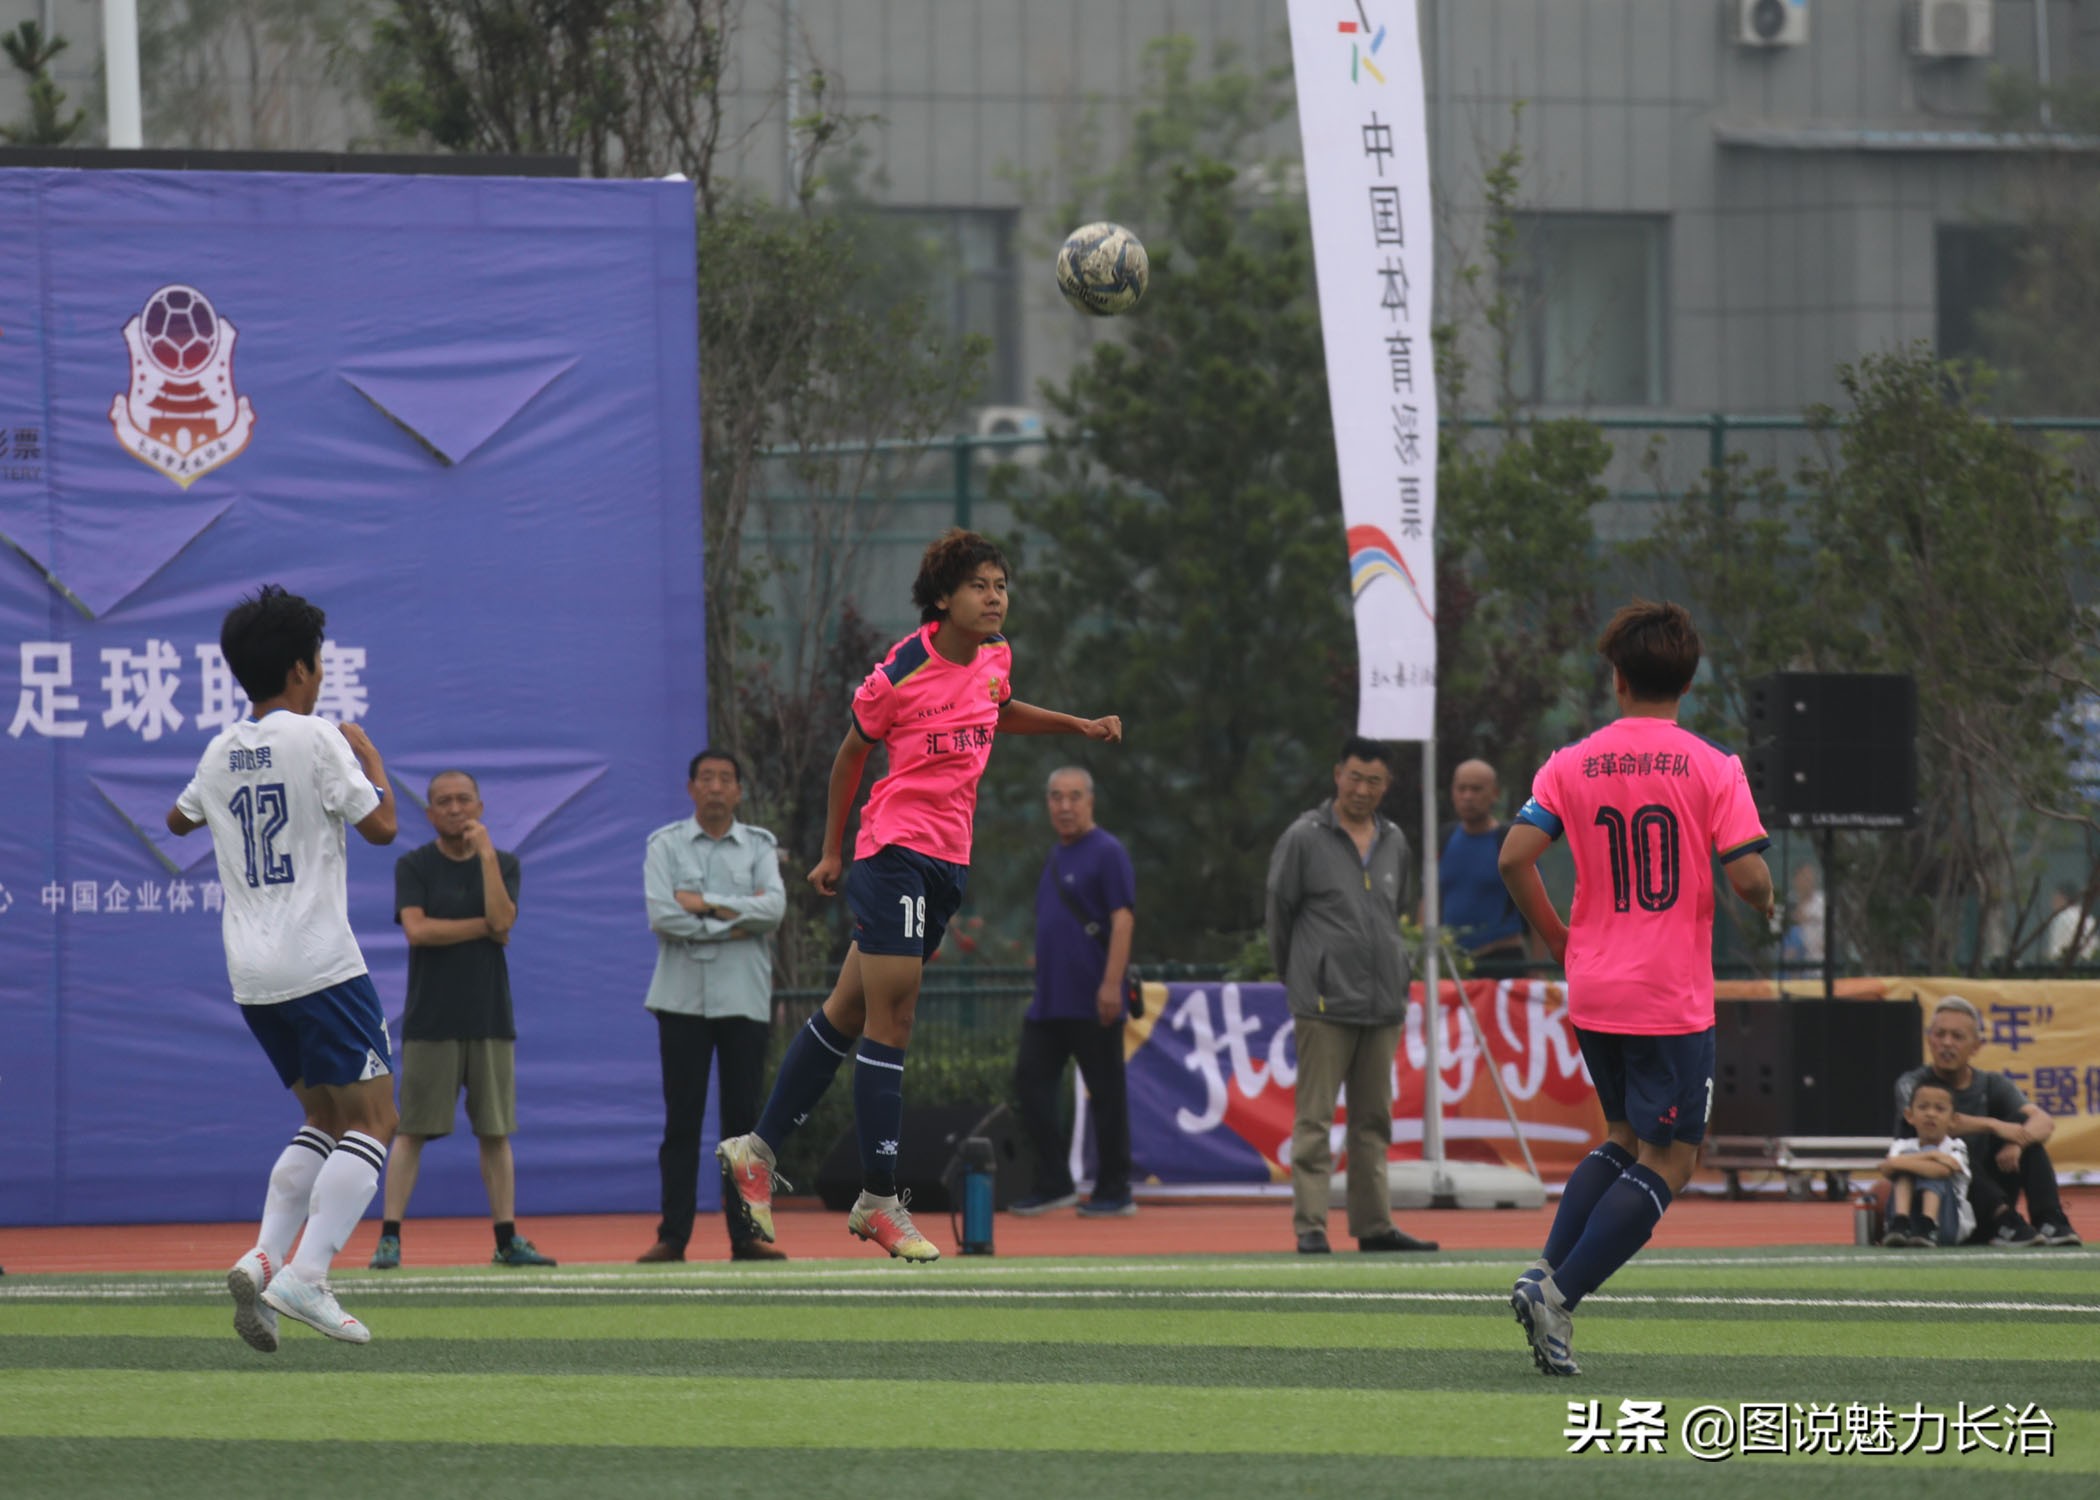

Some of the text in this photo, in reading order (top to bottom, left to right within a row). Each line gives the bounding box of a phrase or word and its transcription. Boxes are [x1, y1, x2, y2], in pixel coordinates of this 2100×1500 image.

[918, 702, 955, 718] KELME
[1583, 752, 1690, 778] 老革命青年队
[228, 783, 295, 888] 12
[1594, 804, 1680, 913] 10
[41, 880, 225, 914] 中国企业体育
[899, 895, 926, 938] 19
[1172, 983, 1482, 1134] Hay
